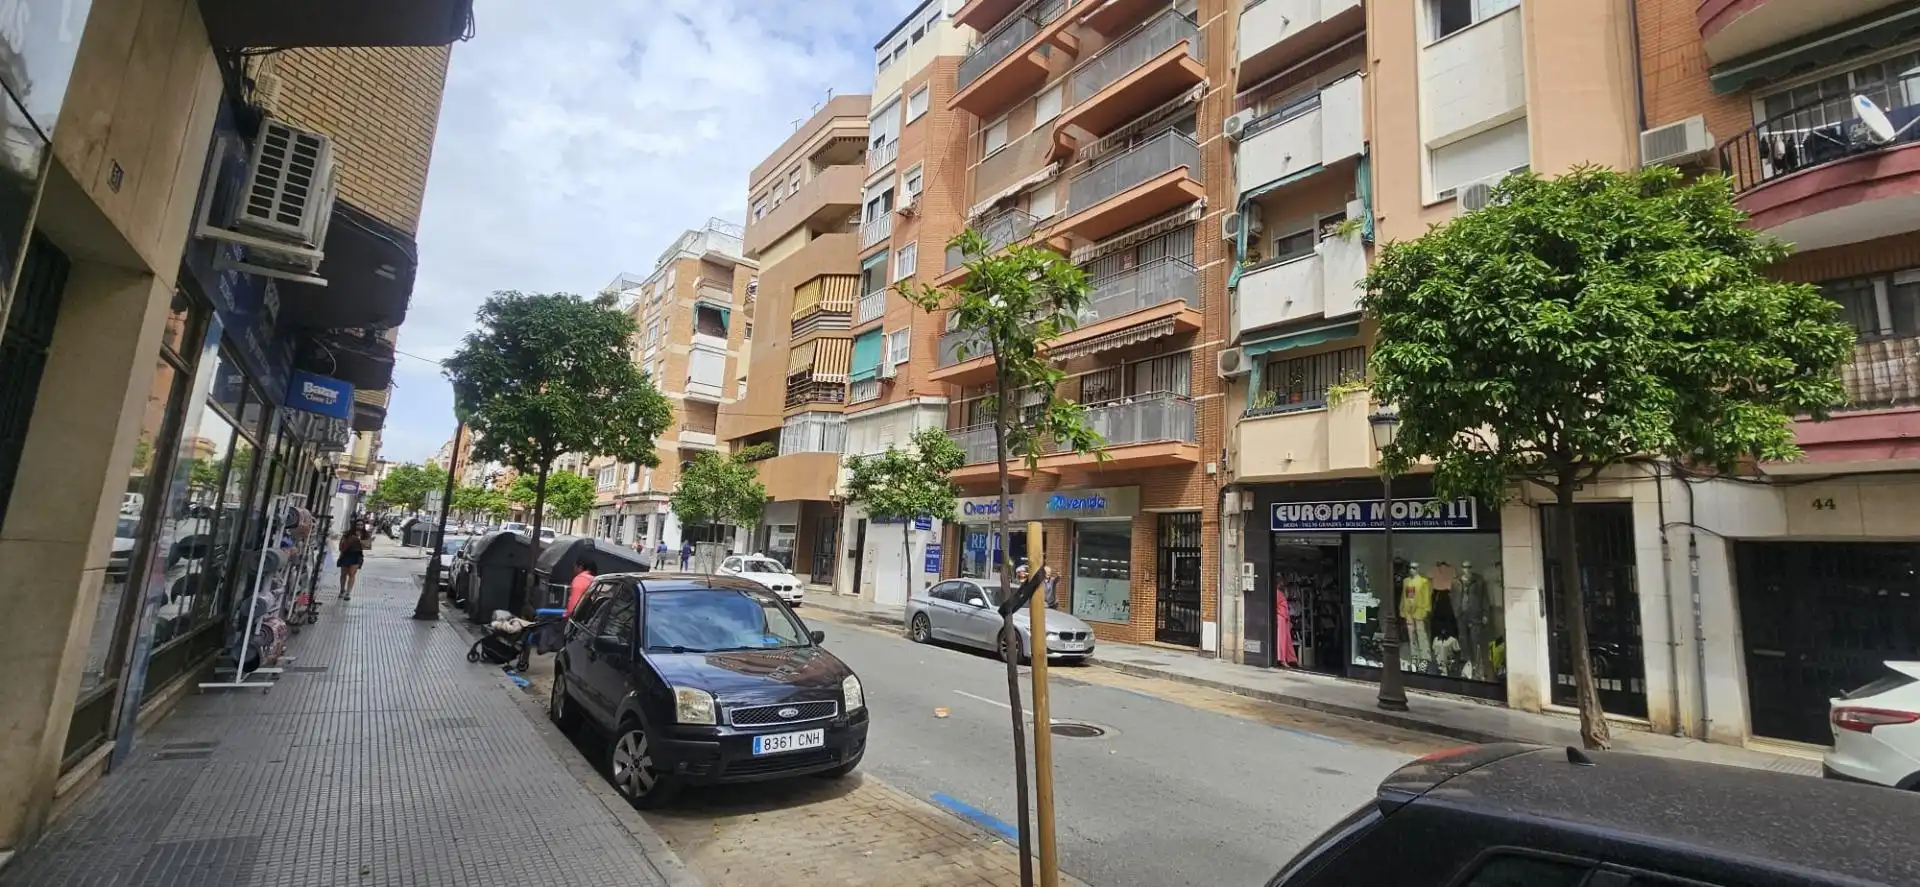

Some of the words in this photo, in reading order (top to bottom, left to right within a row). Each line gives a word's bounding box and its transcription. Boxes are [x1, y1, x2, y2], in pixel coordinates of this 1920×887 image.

[1276, 503, 1361, 521] EUROPA
[1370, 501, 1441, 520] MODA
[1811, 498, 1836, 511] 44
[764, 735, 792, 751] 8361
[798, 731, 820, 746] CNH
